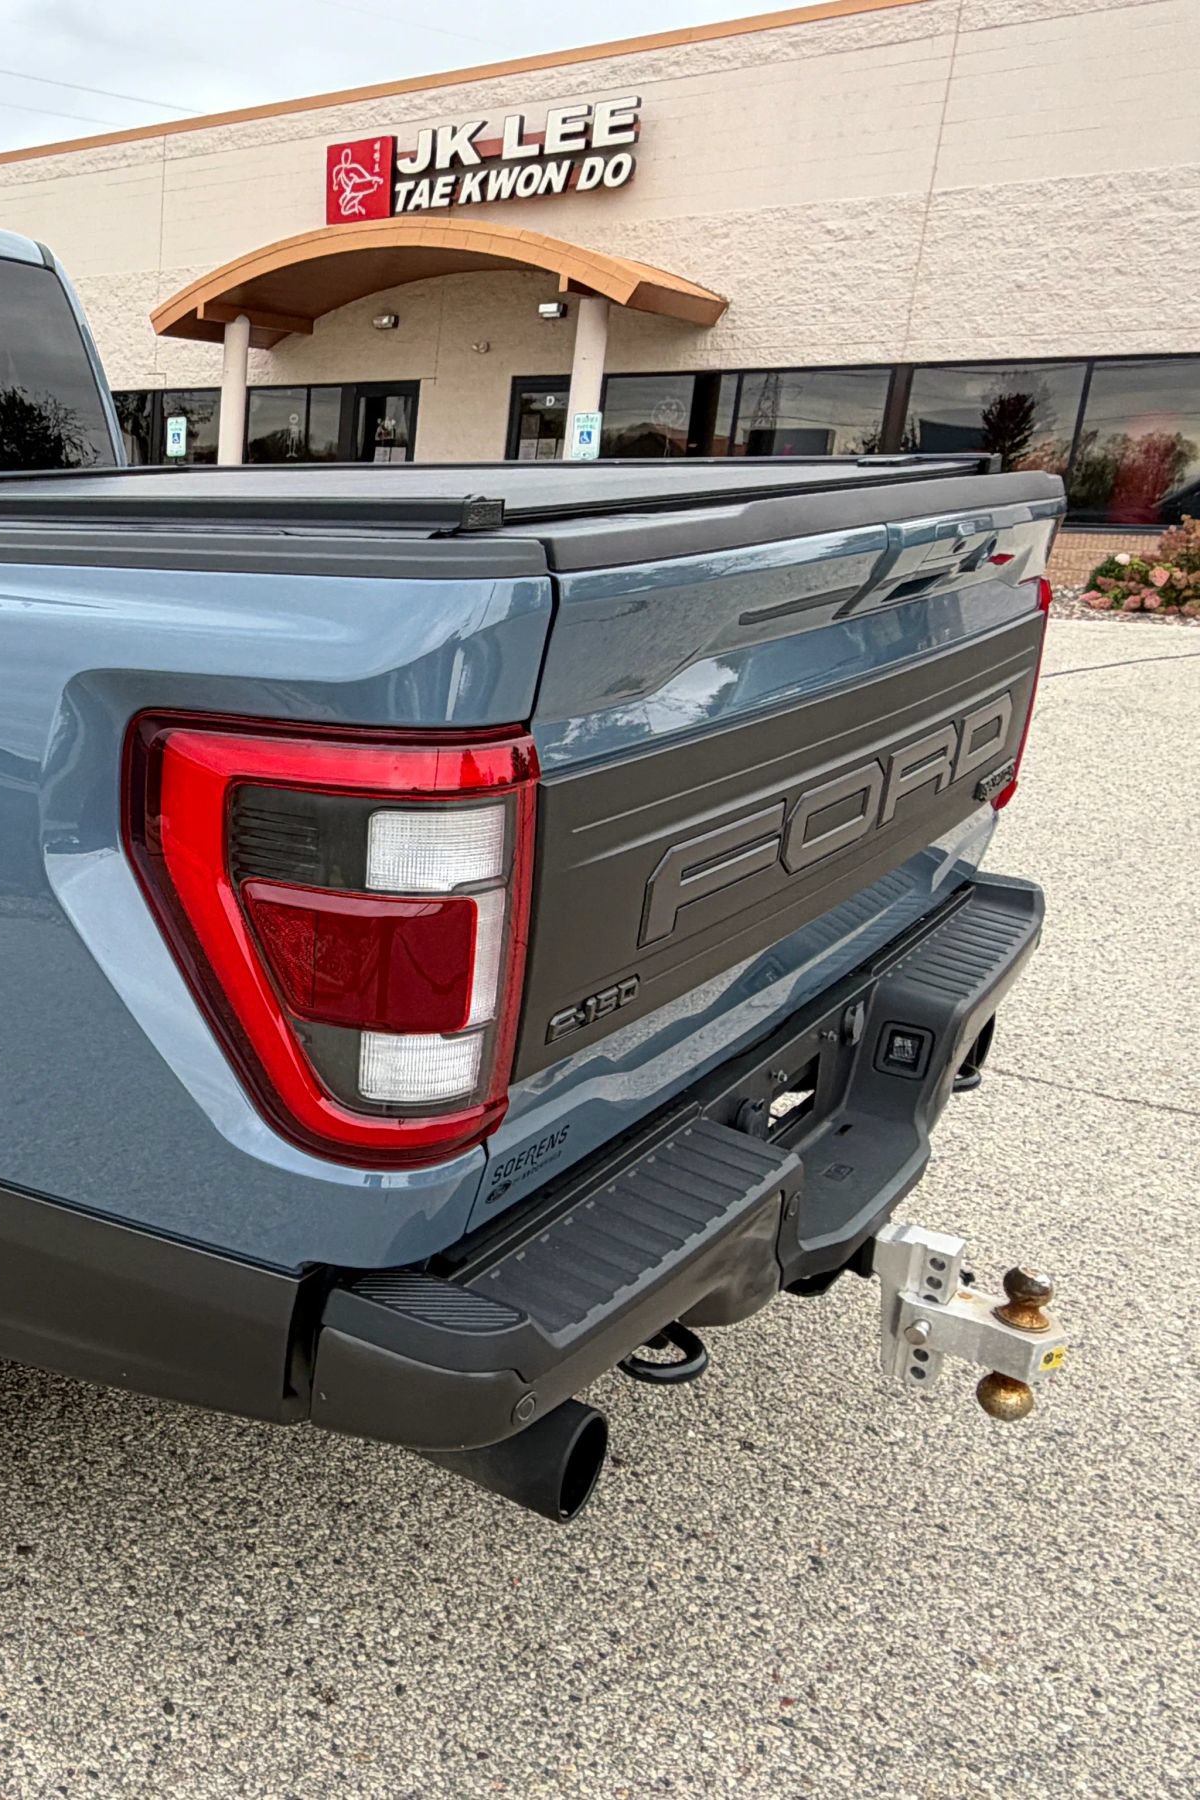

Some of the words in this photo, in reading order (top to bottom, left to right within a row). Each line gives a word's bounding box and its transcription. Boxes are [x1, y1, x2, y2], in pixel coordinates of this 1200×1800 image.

[397, 120, 488, 174] JK
[502, 96, 641, 161] LEE
[395, 174, 455, 213] TAE
[458, 160, 573, 204] KWON
[576, 153, 636, 191] DO
[637, 690, 1013, 950] FORD
[544, 973, 640, 1045] F-150
[491, 1124, 570, 1185] SOERENS
